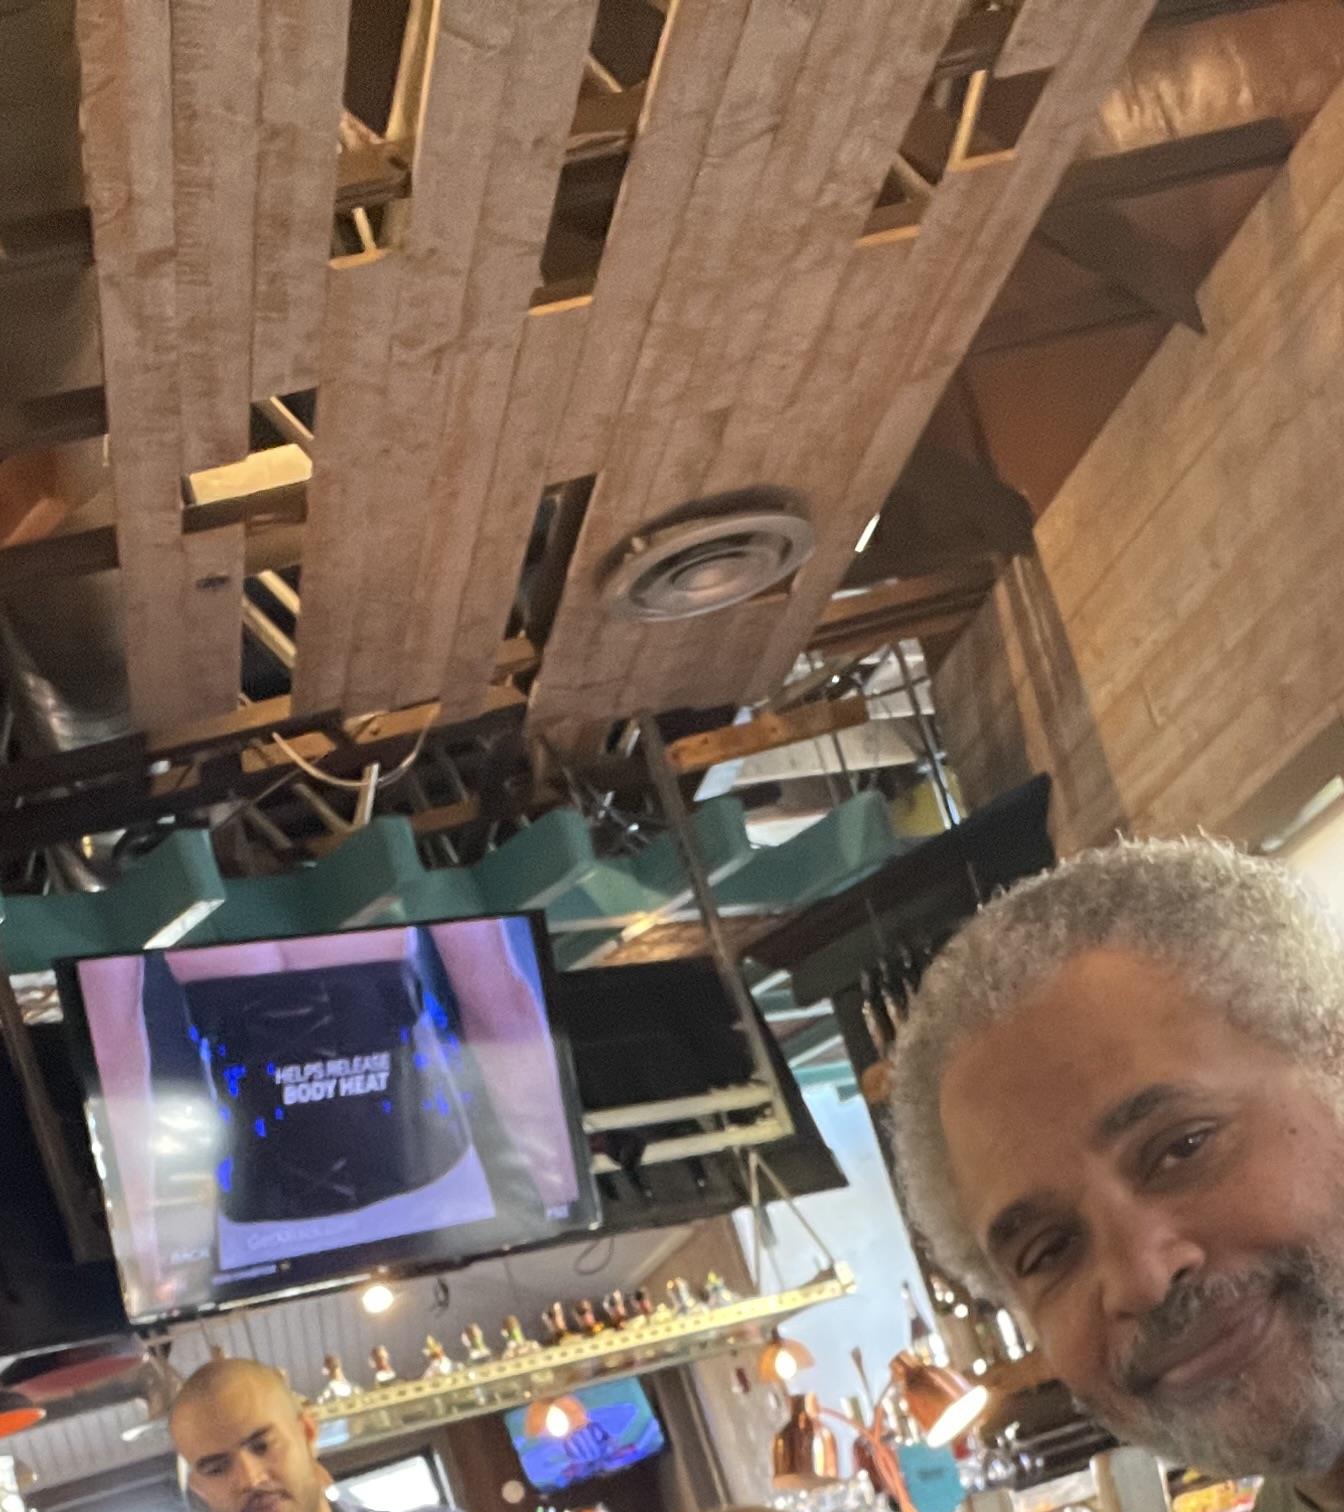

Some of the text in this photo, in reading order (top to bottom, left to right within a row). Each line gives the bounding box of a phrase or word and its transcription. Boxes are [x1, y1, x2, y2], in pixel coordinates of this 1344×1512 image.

[275, 1051, 390, 1084] HELPS RELEASE
[283, 1072, 389, 1105] BODY HEAT
